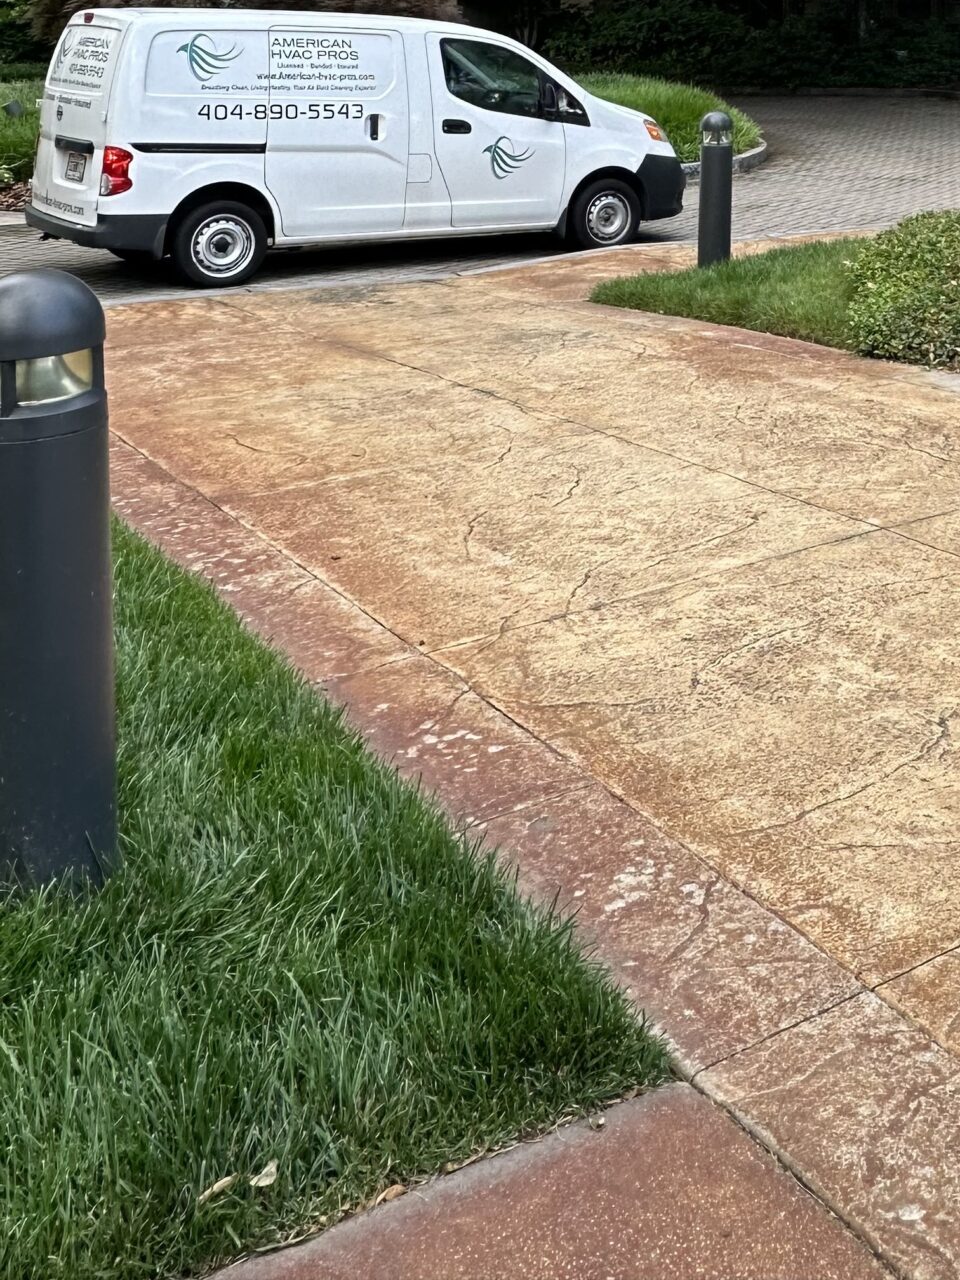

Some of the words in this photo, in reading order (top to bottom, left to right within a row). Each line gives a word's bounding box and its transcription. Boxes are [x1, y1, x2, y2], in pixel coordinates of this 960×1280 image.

[271, 38, 352, 49] AMERICAN
[271, 49, 313, 60] HVAC
[317, 50, 359, 61] PROS
[197, 104, 364, 121] 404-890-5543
